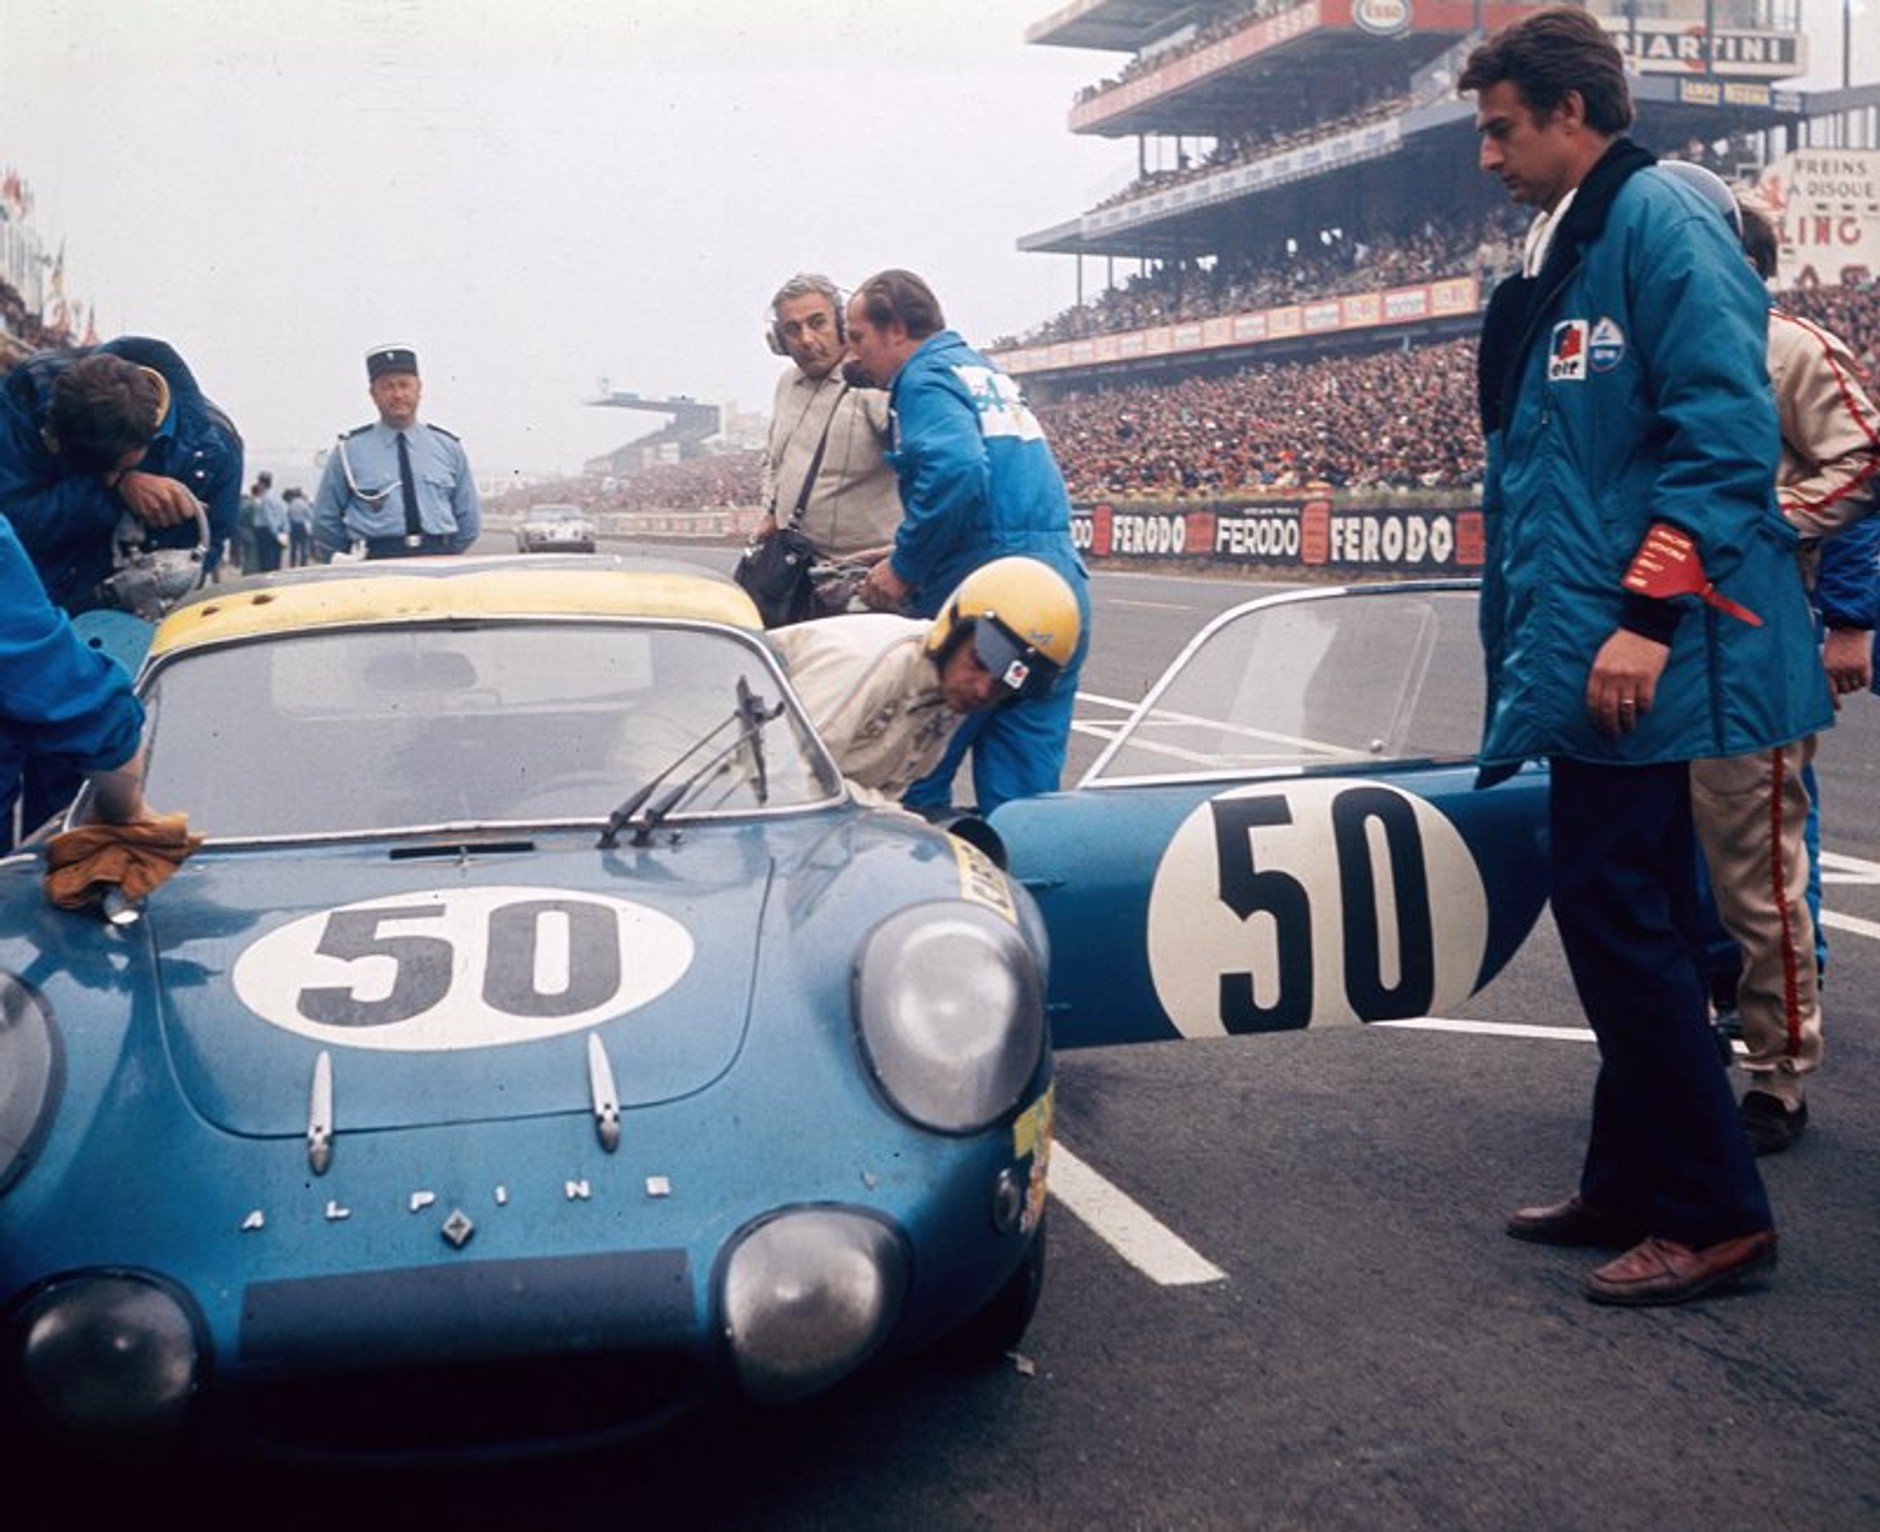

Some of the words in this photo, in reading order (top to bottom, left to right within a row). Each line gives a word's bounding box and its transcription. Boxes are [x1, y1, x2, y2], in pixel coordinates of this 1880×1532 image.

[1795, 159, 1867, 174] FREINS
[1112, 514, 1186, 554] FERODO
[1216, 517, 1299, 556] FERODO
[1330, 515, 1454, 563] FERODO
[1210, 786, 1435, 1036] 50
[296, 899, 622, 1028] 50
